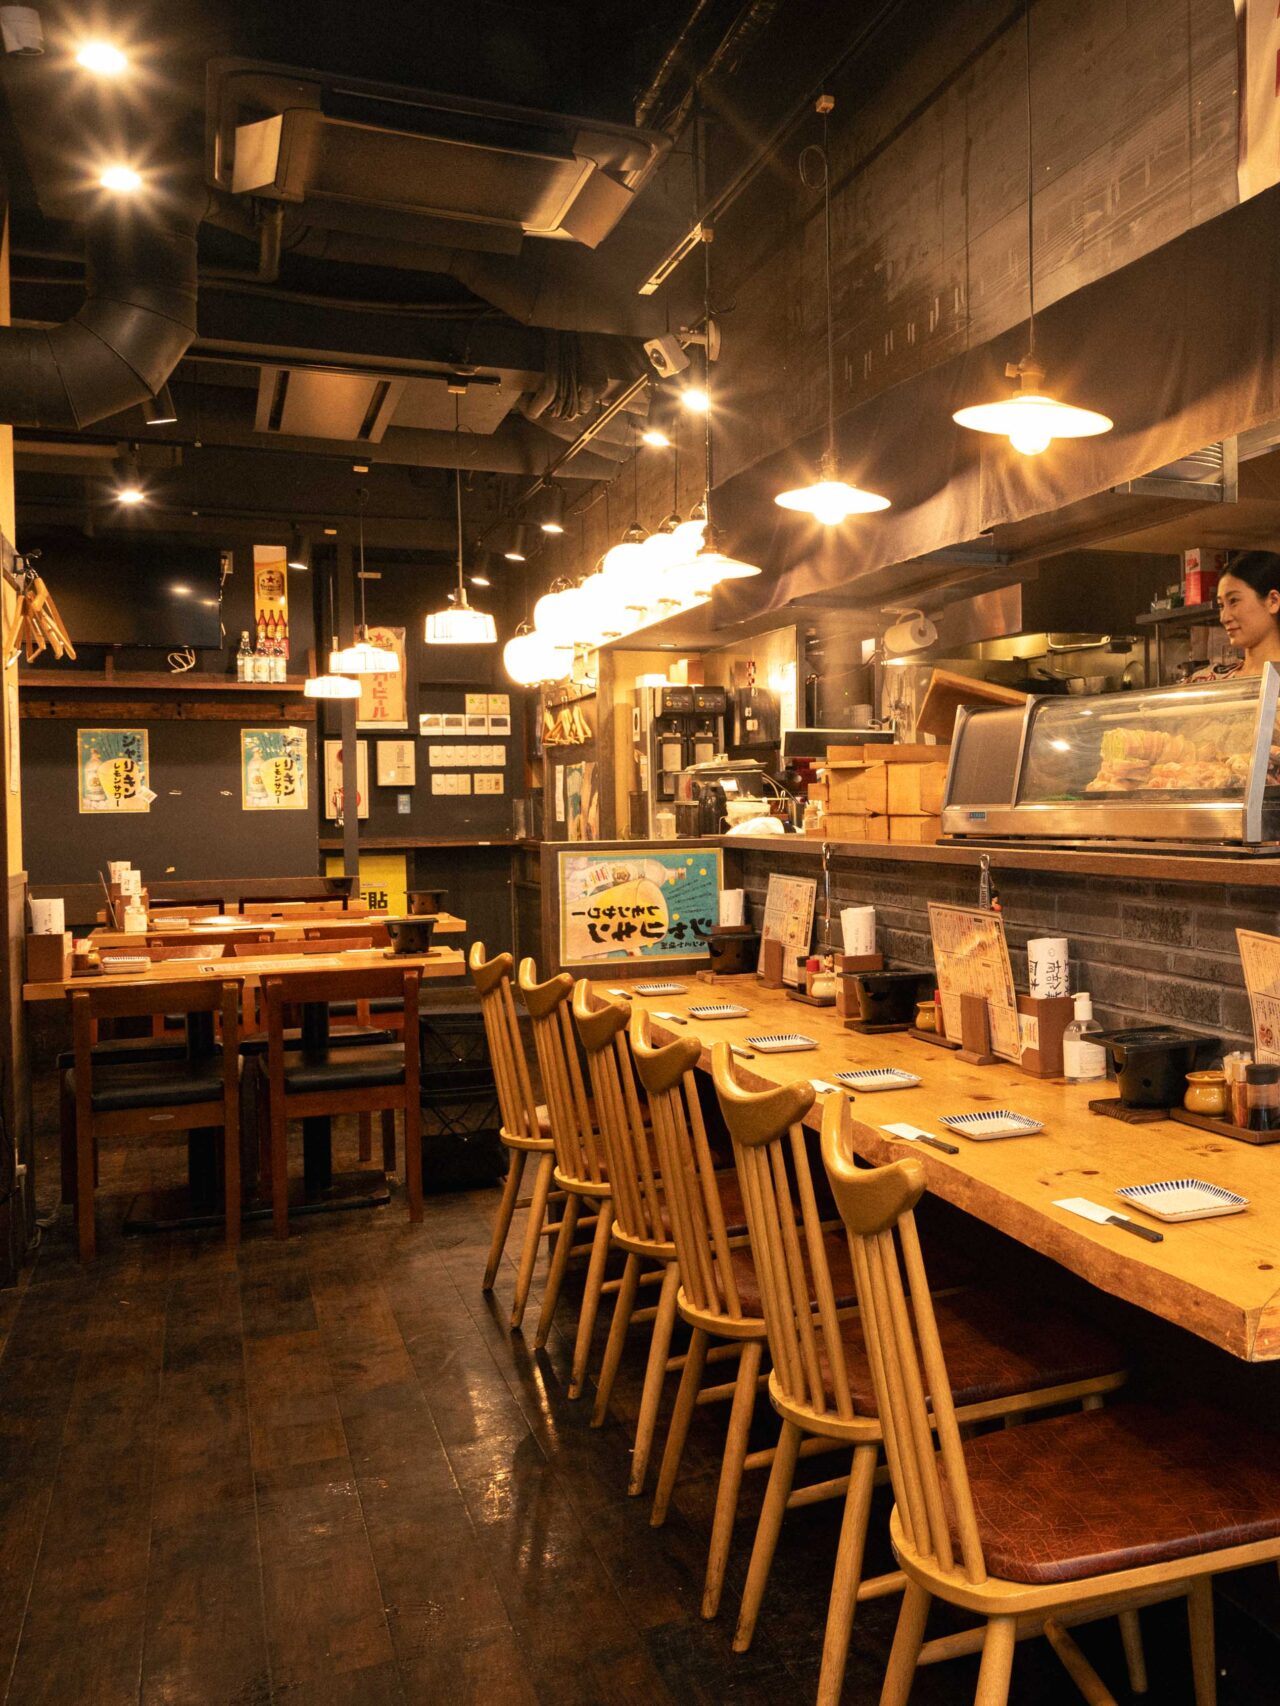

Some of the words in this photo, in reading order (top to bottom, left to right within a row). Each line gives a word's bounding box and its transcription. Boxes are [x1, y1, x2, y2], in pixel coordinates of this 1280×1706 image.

[113, 762, 121, 807] レモンサワー
[571, 904, 661, 920] レモンサワー
[587, 917, 713, 944] シャリキン
